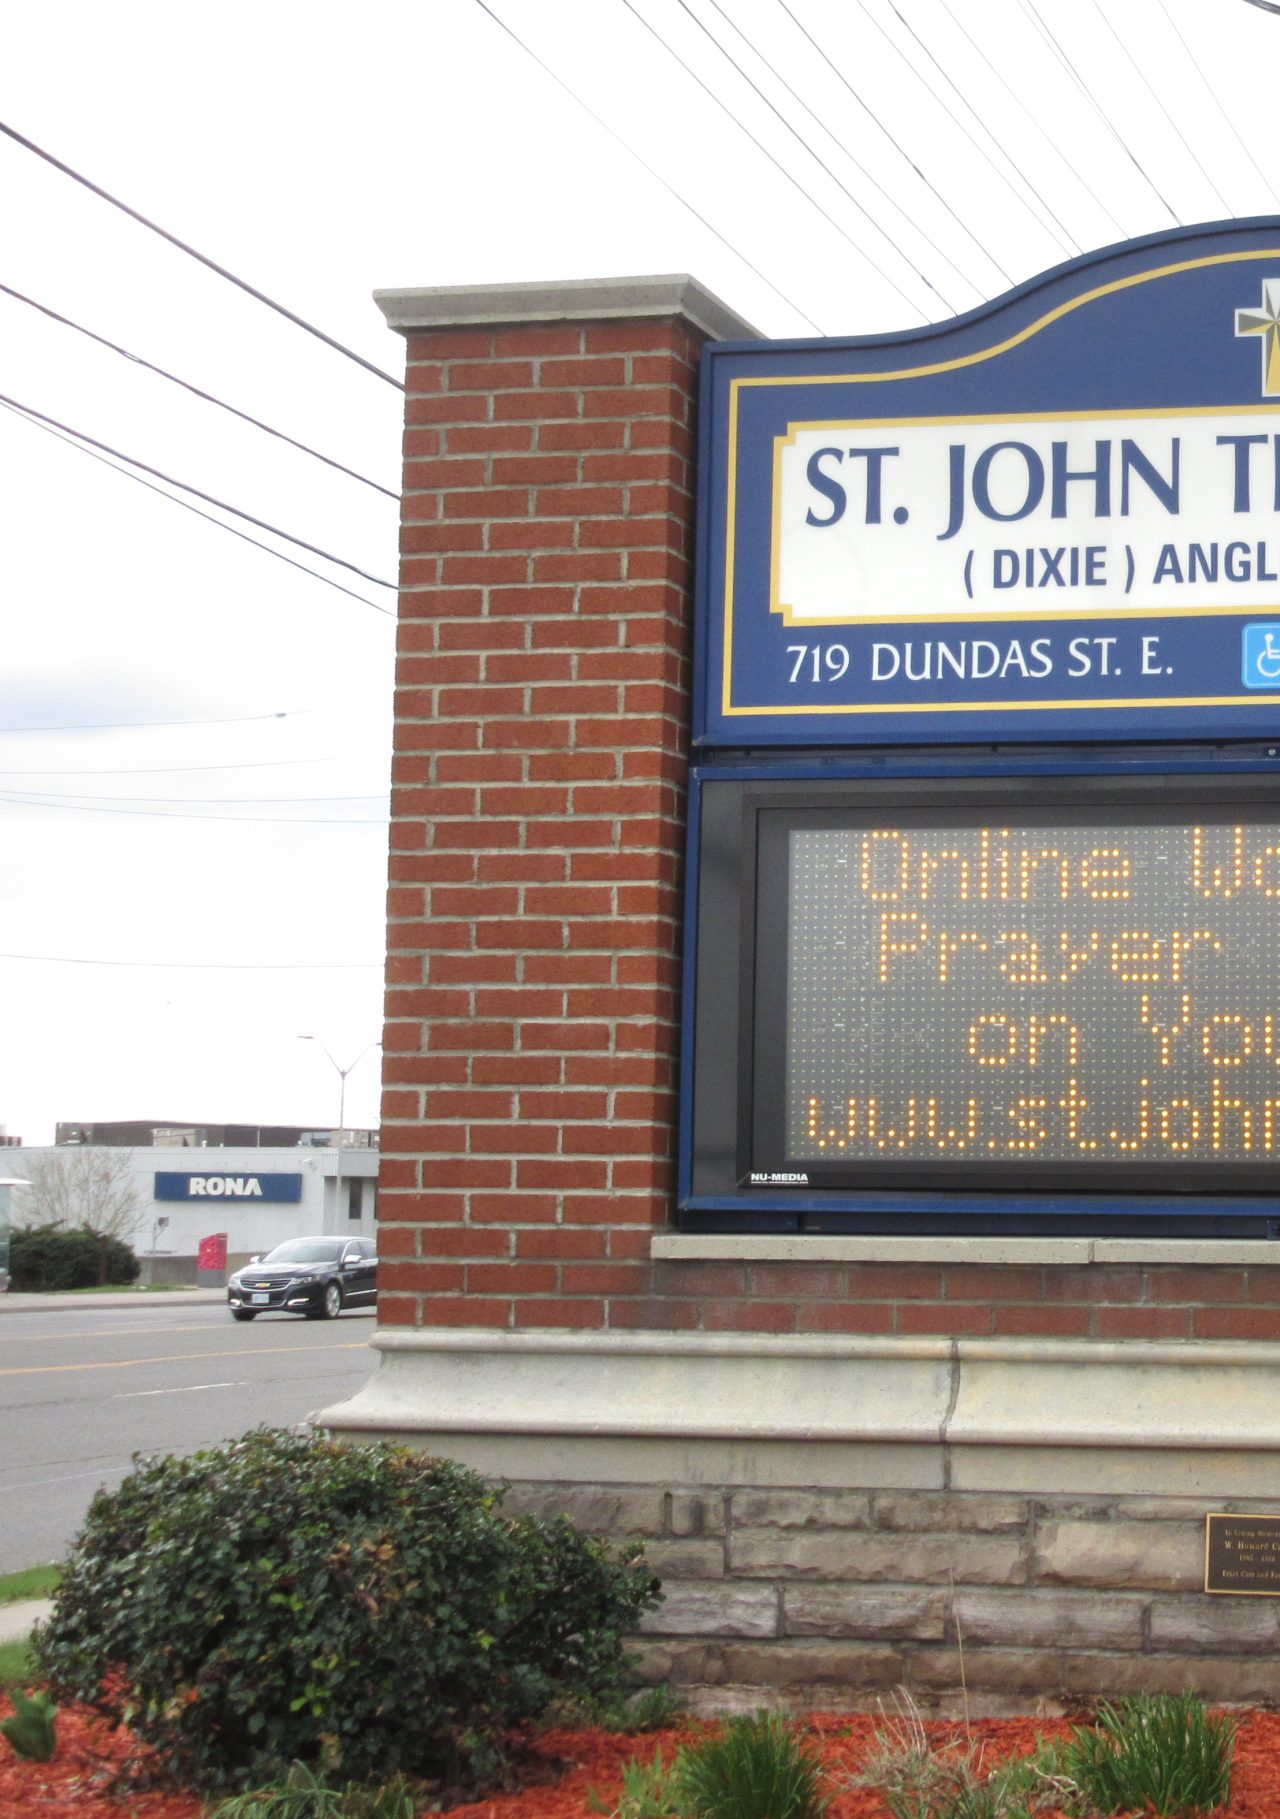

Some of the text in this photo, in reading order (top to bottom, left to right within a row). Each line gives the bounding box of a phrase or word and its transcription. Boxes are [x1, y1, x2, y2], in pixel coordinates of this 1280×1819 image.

[805, 446, 910, 528] ST.
[936, 437, 1181, 541] JOHN
[785, 636, 1174, 683] 719 DUNDAS ST. E.
[861, 827, 1131, 901] Online
[879, 911, 1221, 983] Prayer
[968, 1014, 1078, 1066] on
[189, 1177, 262, 1196] RONA
[750, 1173, 809, 1181] NU-MEDIA
[1237, 1540, 1269, 1550] Howard
